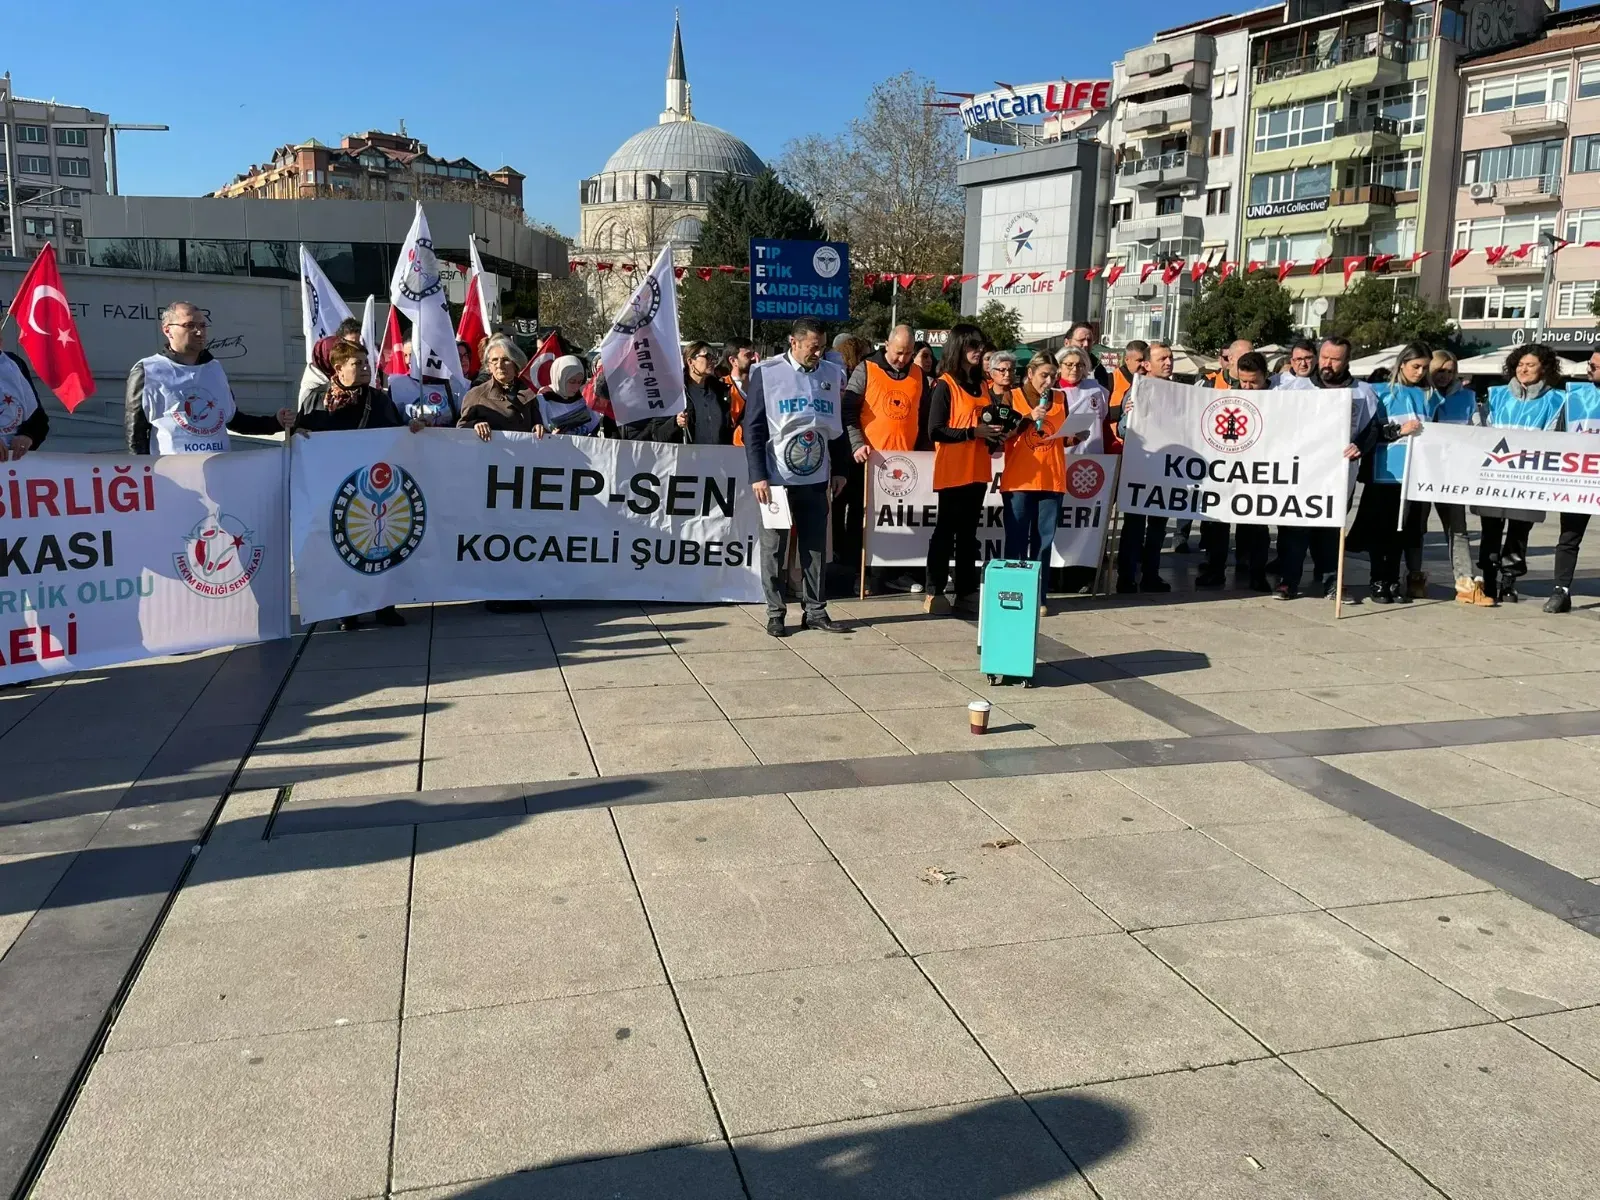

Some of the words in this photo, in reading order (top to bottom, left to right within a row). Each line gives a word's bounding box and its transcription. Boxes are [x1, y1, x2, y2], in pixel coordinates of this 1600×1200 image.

[1247, 204, 1272, 217] UNIQ
[1273, 205, 1285, 214] Art
[755, 246, 781, 259] TIP
[756, 263, 792, 278] ETİK
[756, 282, 844, 300] KARDEŞLİK
[756, 300, 839, 316] SENDİKASI
[779, 399, 834, 414] HEP-SEN
[1164, 454, 1300, 485] KOCAELİ
[486, 465, 736, 517] HEP-SEN
[1127, 482, 1221, 514] TABİP
[1231, 493, 1333, 519] ODASI
[1417, 483, 1434, 492] YA
[1441, 485, 1469, 494] HEP
[334, 483, 360, 566] HEP-SEN
[365, 558, 391, 572] HEP
[400, 479, 424, 558] SENİNLE
[877, 499, 937, 528] AİLE
[457, 531, 619, 563] KOCAELİ
[630, 535, 753, 570] ŞUBESİ
[77, 575, 154, 605] OLDU
[0, 613, 78, 667] ELİ
